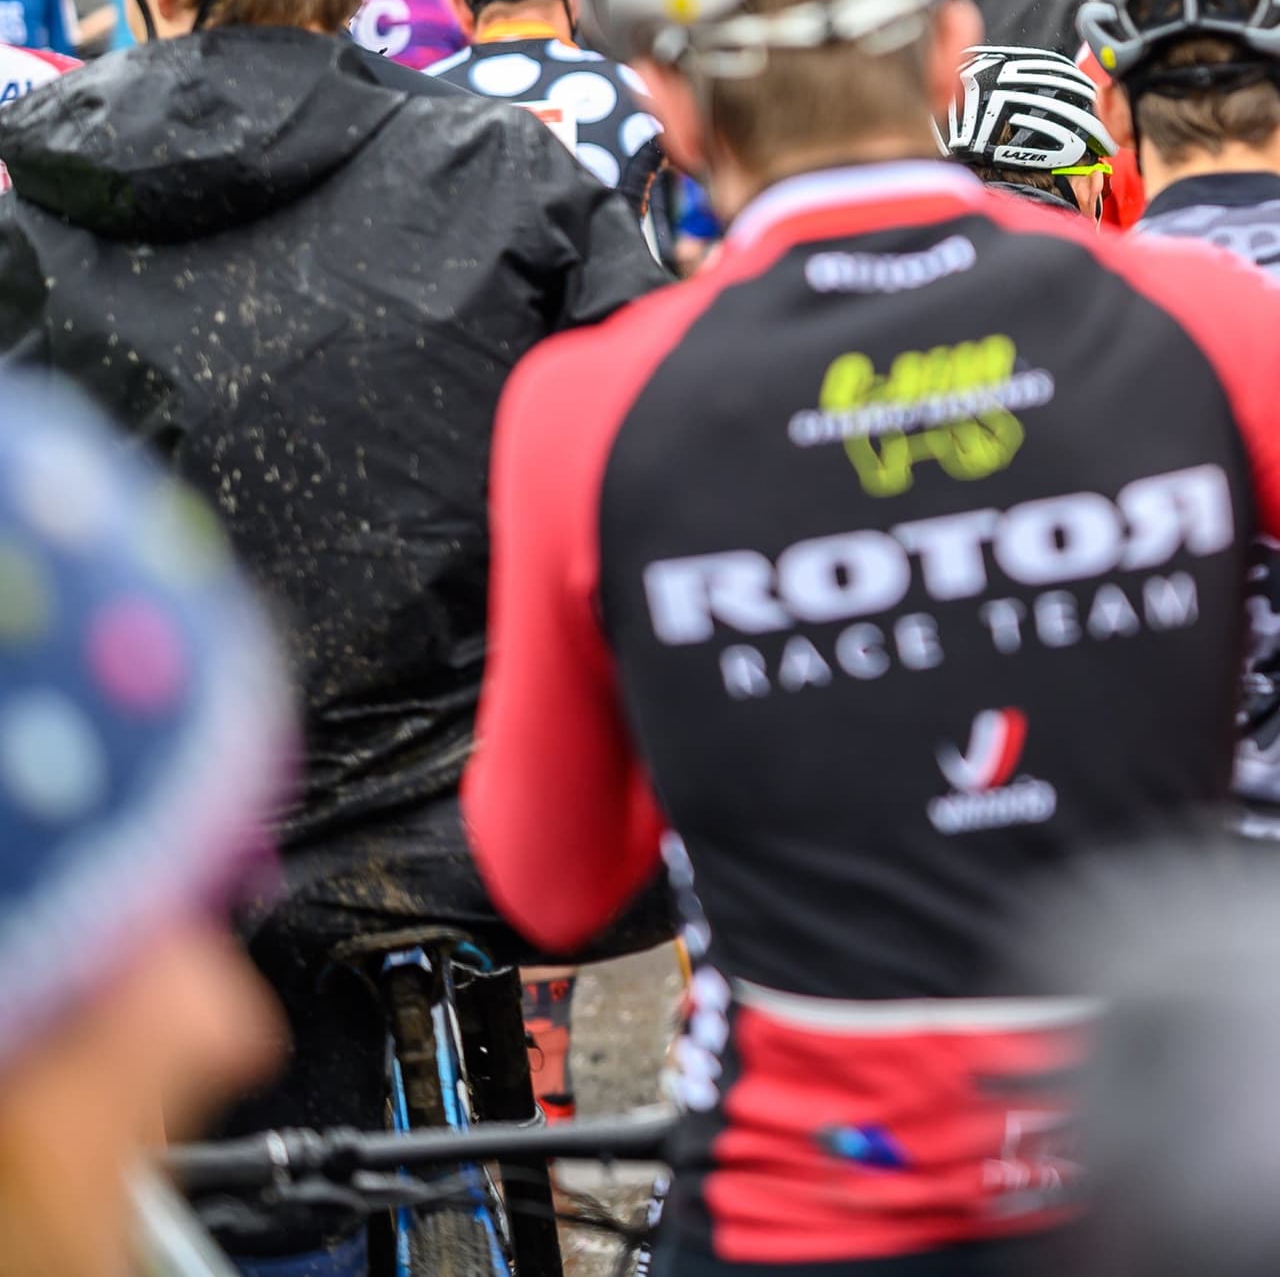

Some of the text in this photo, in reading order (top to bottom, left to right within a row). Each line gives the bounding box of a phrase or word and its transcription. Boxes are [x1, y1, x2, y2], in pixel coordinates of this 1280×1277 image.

[1001, 150, 1048, 162] LAZER
[643, 463, 1235, 647] ROTOR
[718, 570, 1199, 700] RACE TEAM
